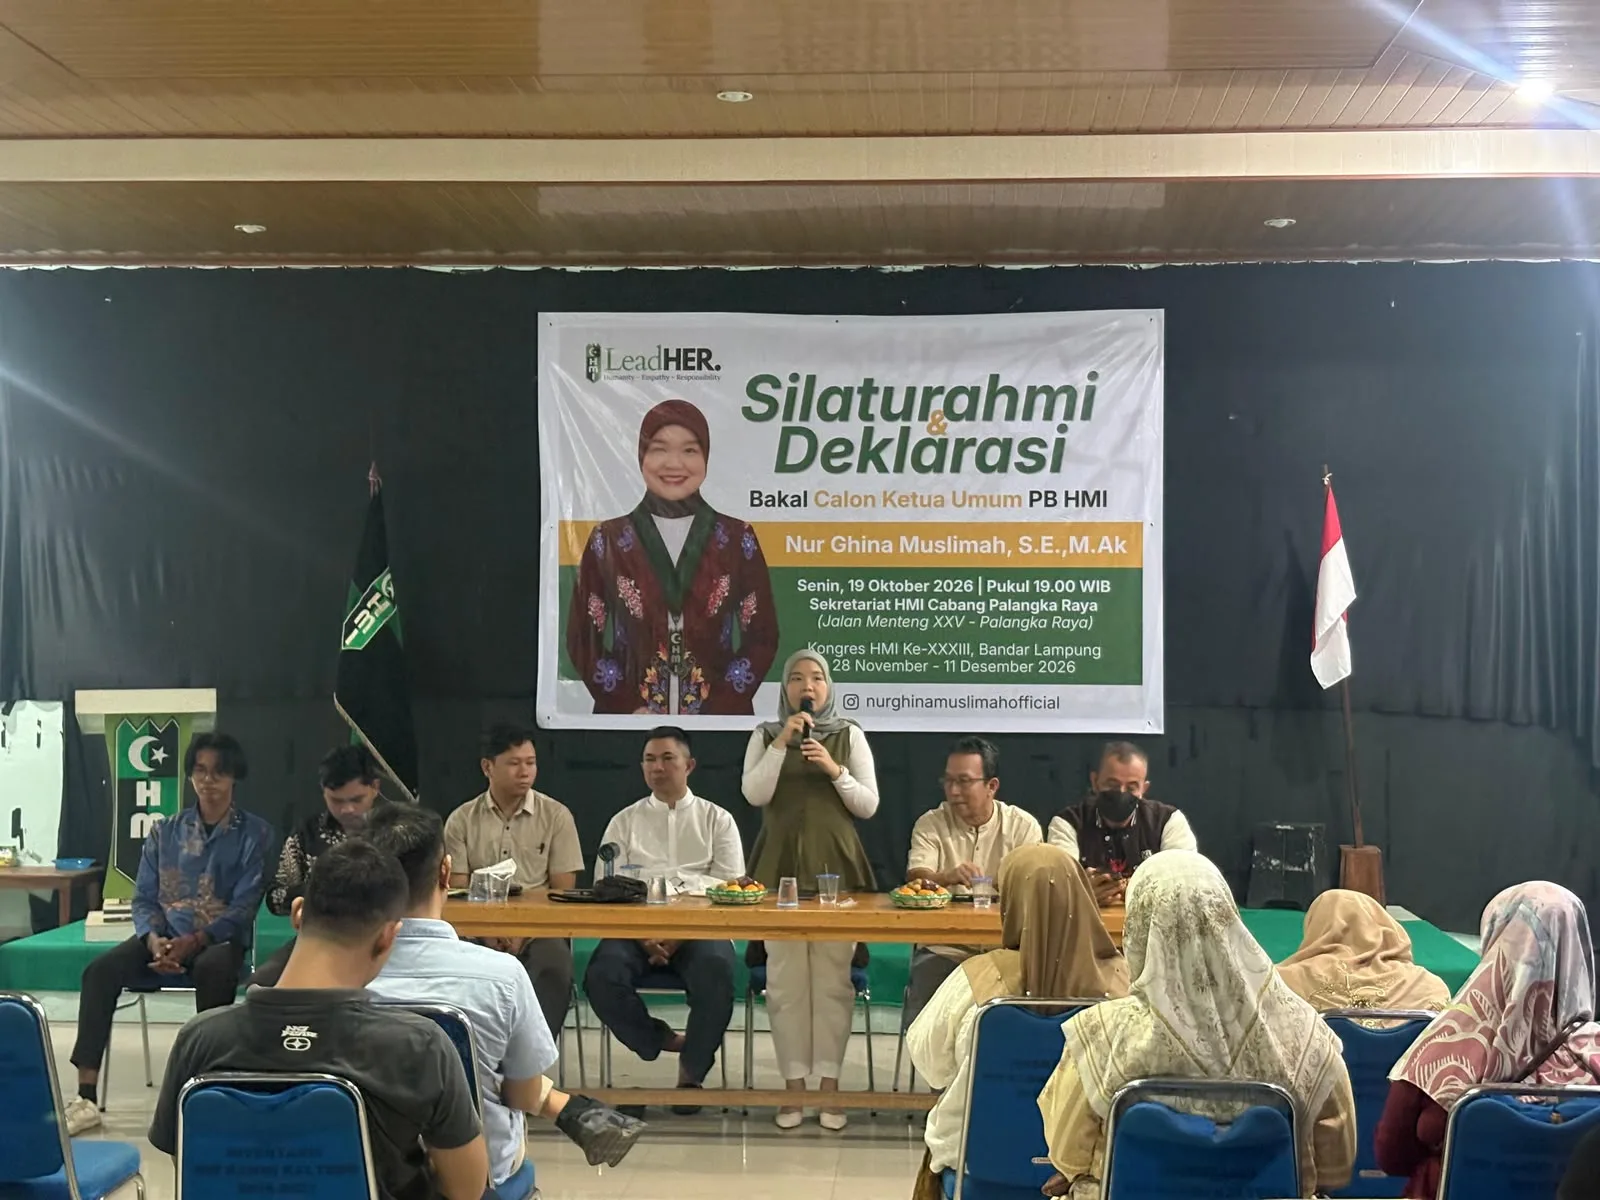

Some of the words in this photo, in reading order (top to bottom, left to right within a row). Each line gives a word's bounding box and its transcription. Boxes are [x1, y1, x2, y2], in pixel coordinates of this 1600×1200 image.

[604, 344, 722, 372] LeadHER.
[641, 374, 670, 383] Empathy
[676, 374, 721, 383] Responsibility
[741, 370, 1099, 423] Silaturahmi
[926, 409, 948, 436] &
[774, 423, 1069, 474] Deklarasi
[750, 490, 808, 508] Bakal
[814, 490, 876, 508] Calon
[882, 490, 945, 508] Ketua
[951, 490, 1022, 508] Umum
[1029, 490, 1058, 508] PB
[1064, 490, 1108, 508] HMI
[785, 535, 825, 553] Nur
[831, 535, 893, 553] Ghina
[900, 535, 1012, 558] Muslimah,
[1018, 535, 1128, 558] S.E.,M.Ak
[797, 579, 844, 595] Senin,
[848, 579, 865, 592] 19
[868, 579, 930, 593] Oktober
[933, 579, 974, 593] 2026
[987, 580, 1030, 593] Pukul
[1033, 580, 1076, 593] 19.00
[1080, 580, 1111, 593] WIB
[809, 598, 891, 611] Sekretariat
[895, 598, 924, 611] HMI
[928, 598, 986, 614] Cabang
[989, 599, 1058, 614] Palangka
[1061, 599, 1098, 614] Raya
[817, 614, 862, 629] (Jalan
[866, 615, 929, 631] Menteng
[933, 615, 966, 628] XXV
[980, 616, 1048, 631] Palangka
[1052, 616, 1094, 631] Raya)
[807, 642, 866, 657] Kongres
[870, 642, 898, 655] HMI
[903, 642, 974, 657] Ke-XXXIII,
[979, 643, 1030, 656] Bandar
[1035, 643, 1102, 660] Lampung
[832, 659, 850, 672] 28
[855, 659, 929, 672] November
[944, 660, 956, 672] 11
[960, 660, 1034, 673] Desember
[1038, 660, 1076, 673] 2026
[866, 694, 1060, 711] nurghinamuslimahofficial
[130, 781, 165, 839] HM
